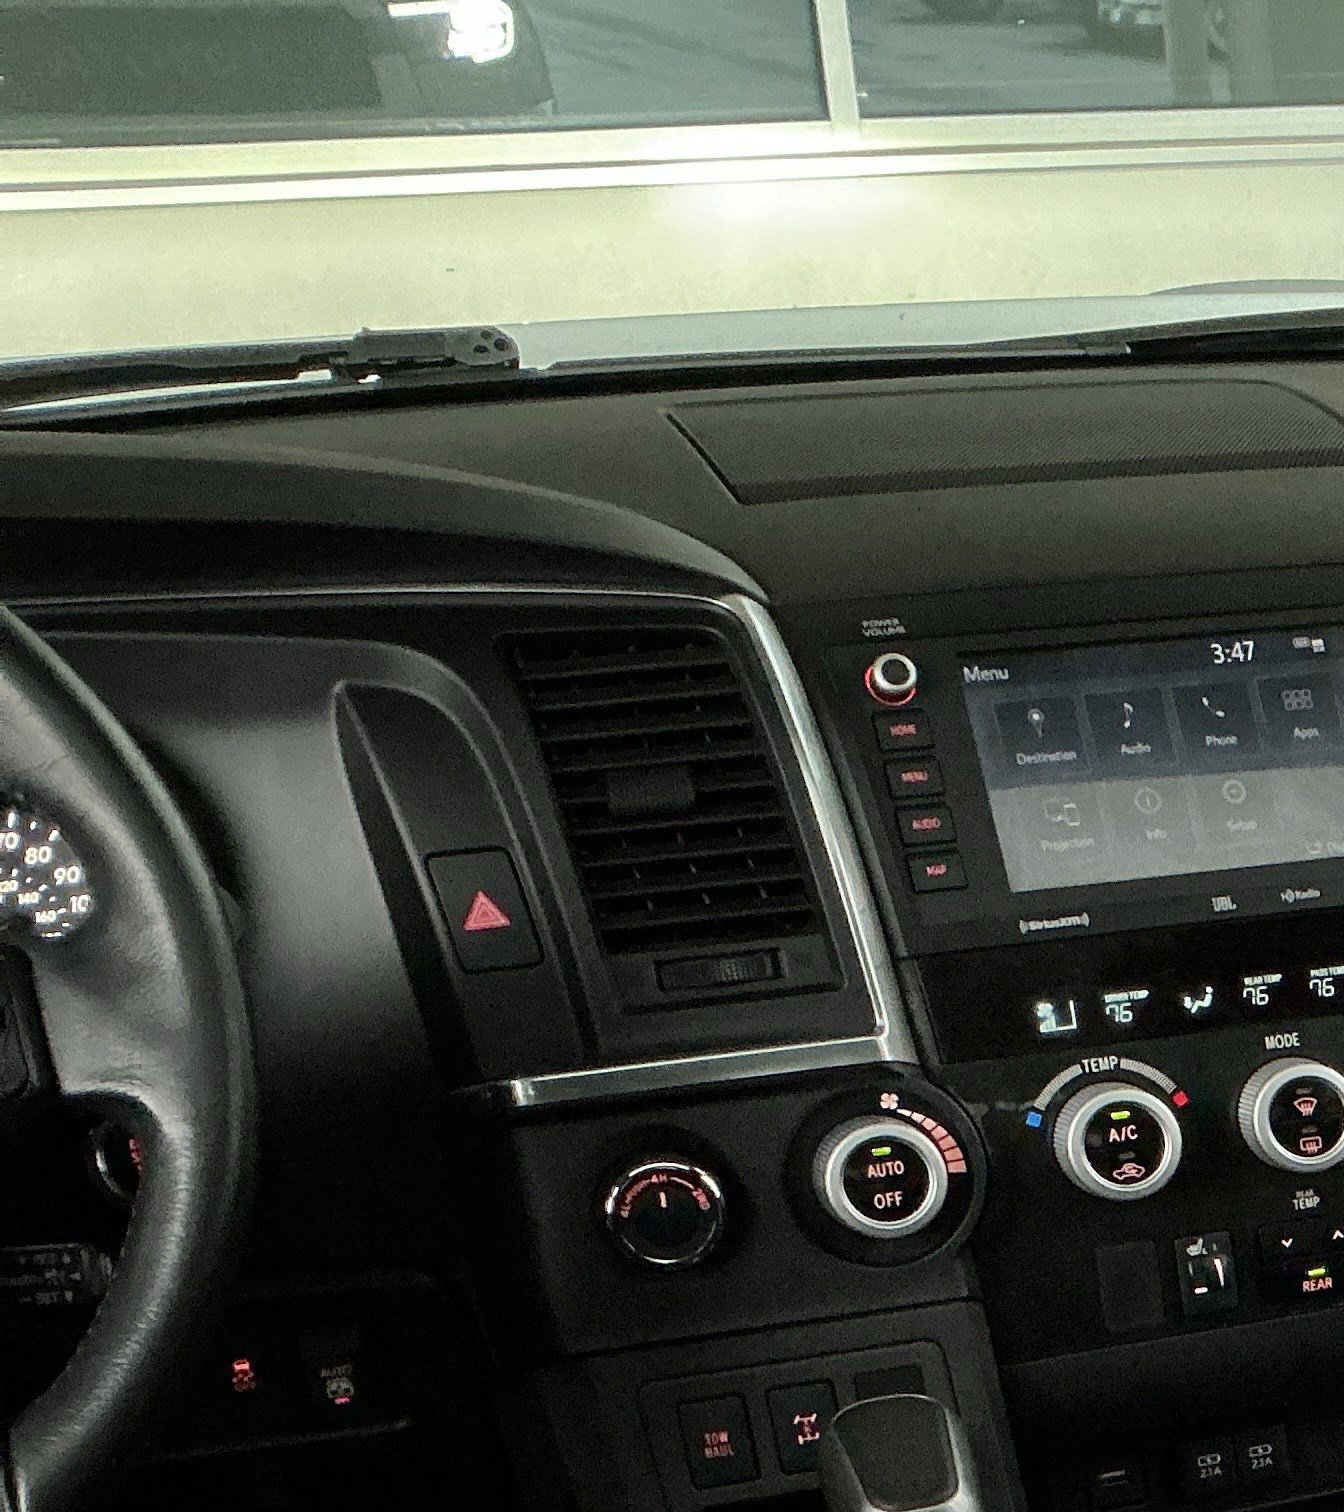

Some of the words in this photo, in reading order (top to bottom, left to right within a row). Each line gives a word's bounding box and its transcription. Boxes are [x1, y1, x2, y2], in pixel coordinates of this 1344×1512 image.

[861, 625, 907, 637] VOLUME
[1210, 640, 1255, 664] 3:47
[963, 665, 1010, 684] Menu
[1205, 733, 1239, 748] Phone
[1293, 726, 1320, 741] Apps
[1016, 749, 1077, 766] Destination
[1120, 741, 1152, 756] Audio
[24, 846, 52, 865] 80
[54, 865, 80, 885] 90
[1212, 895, 1237, 912] JBL
[1263, 973, 1283, 984] TEMP
[1309, 977, 1335, 997] 76
[1243, 985, 1269, 1006] 76
[1105, 1002, 1133, 1023] 76
[1264, 1031, 1301, 1051] MODE
[1081, 1055, 1119, 1074] TEMP
[1108, 1124, 1139, 1144] A/C
[867, 1160, 905, 1179] AUTO
[873, 1191, 904, 1210] OFF
[1292, 1195, 1320, 1211] TEMP
[1302, 1276, 1333, 1293] REAR
